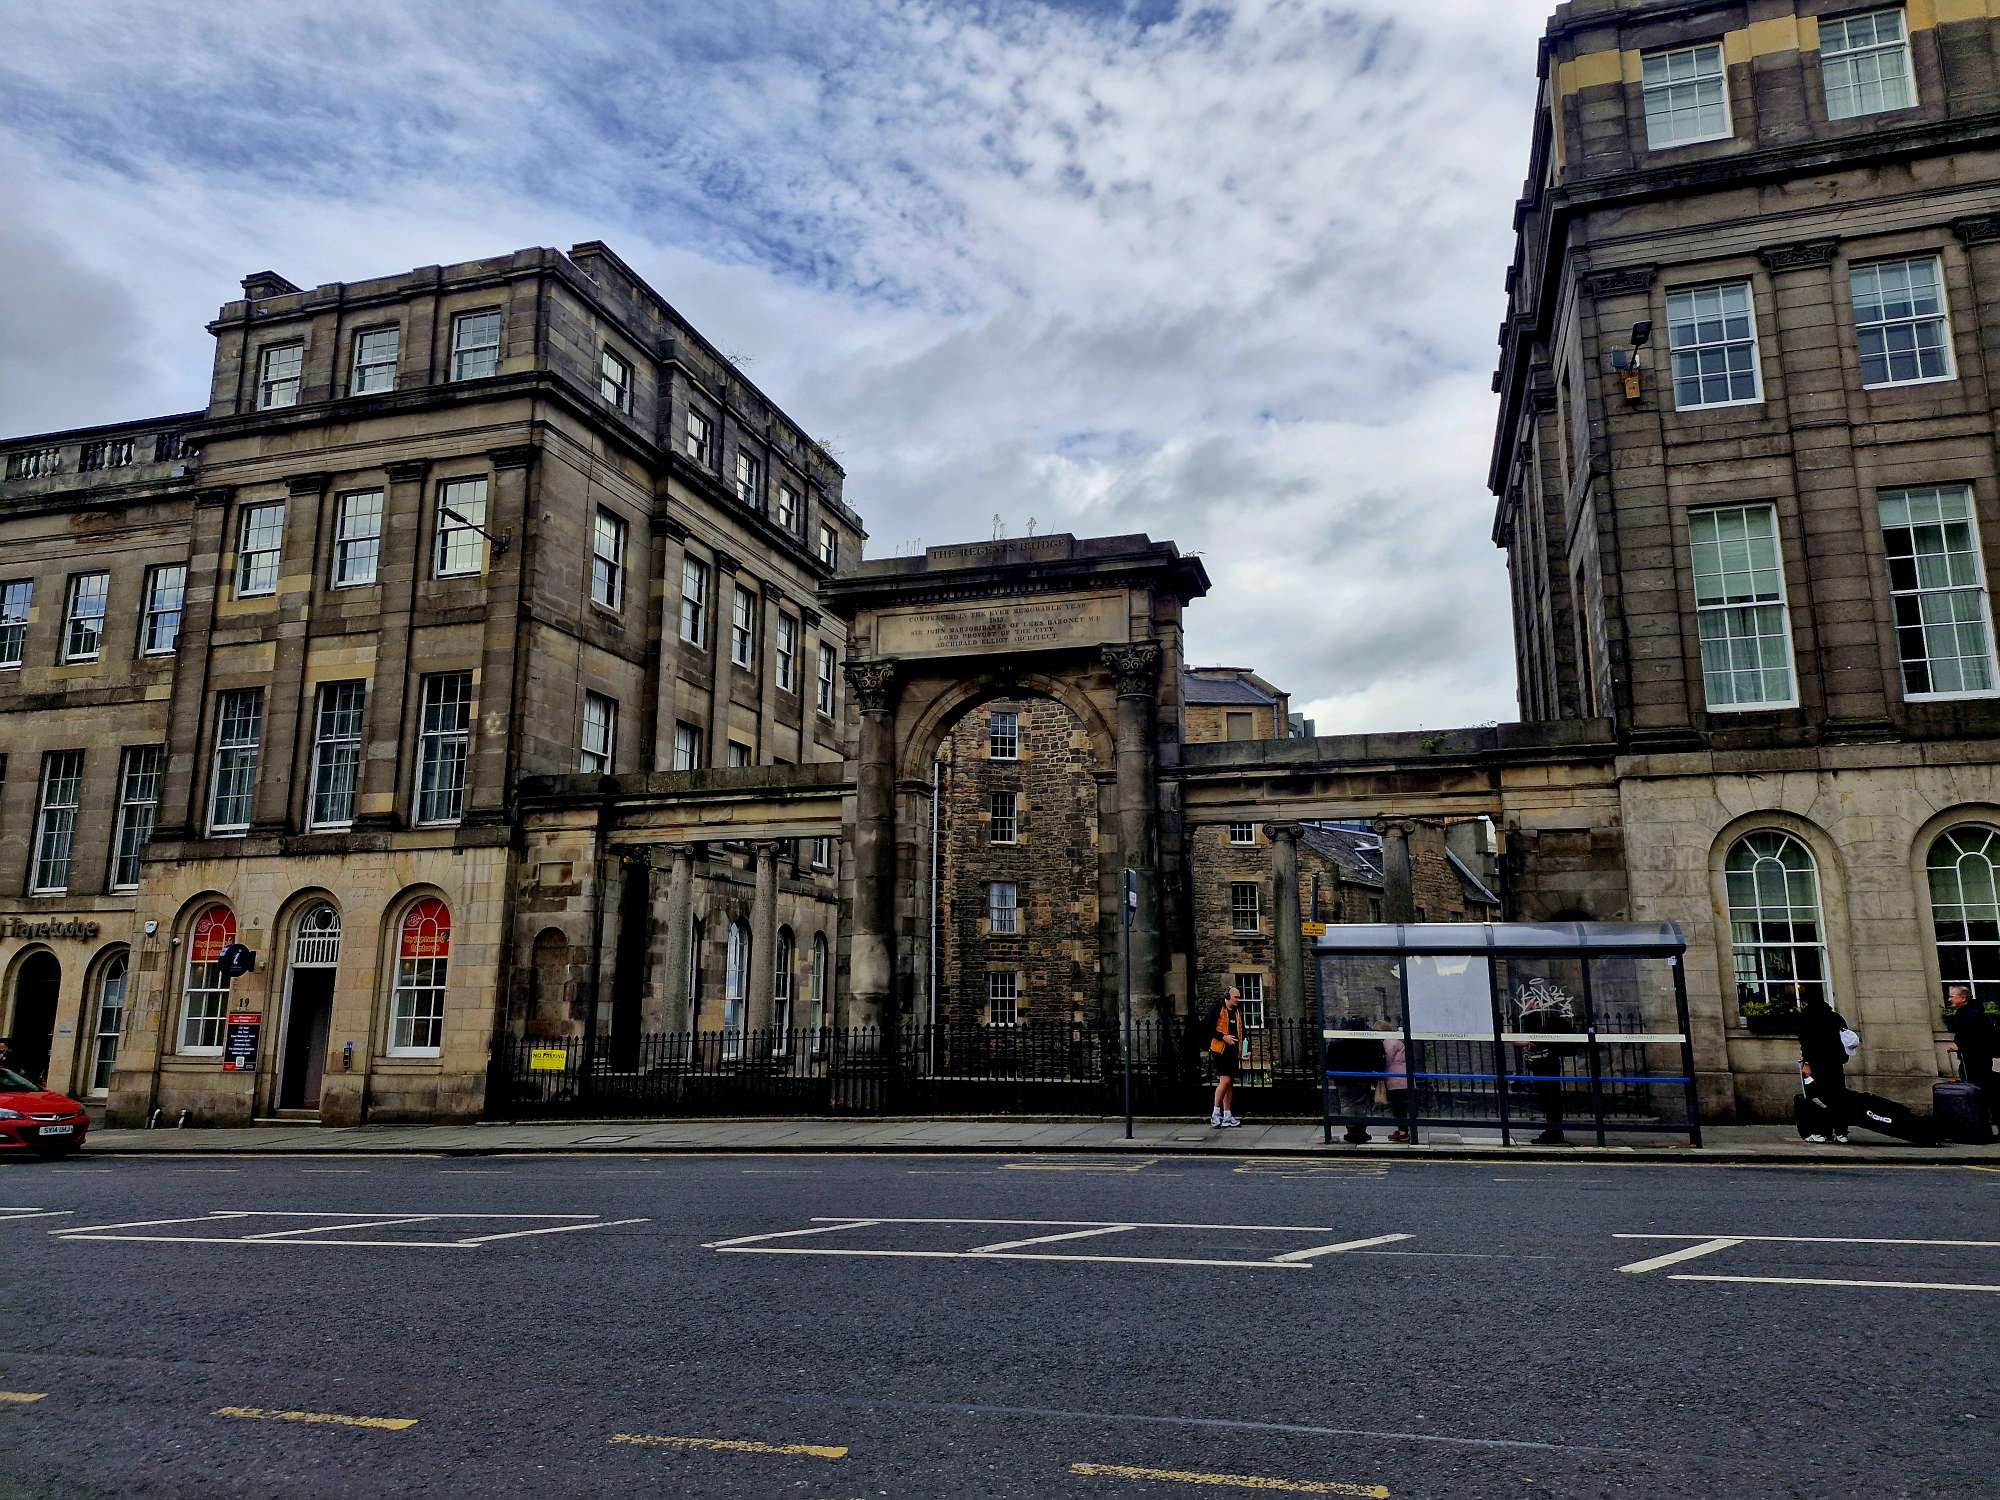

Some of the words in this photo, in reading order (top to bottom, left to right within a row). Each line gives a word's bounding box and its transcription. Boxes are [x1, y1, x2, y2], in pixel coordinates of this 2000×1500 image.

[931, 550, 955, 559] THE
[960, 543, 1016, 557] REGENTS
[1020, 538, 1065, 551] BRIDGE
[989, 608, 1009, 616] EVER
[1012, 604, 1063, 614] MEMORABLE
[927, 627, 945, 635] JOHN
[962, 631, 997, 639] PROVOST
[981, 637, 1009, 645] ELLIOT
[239, 997, 250, 1008] 19
